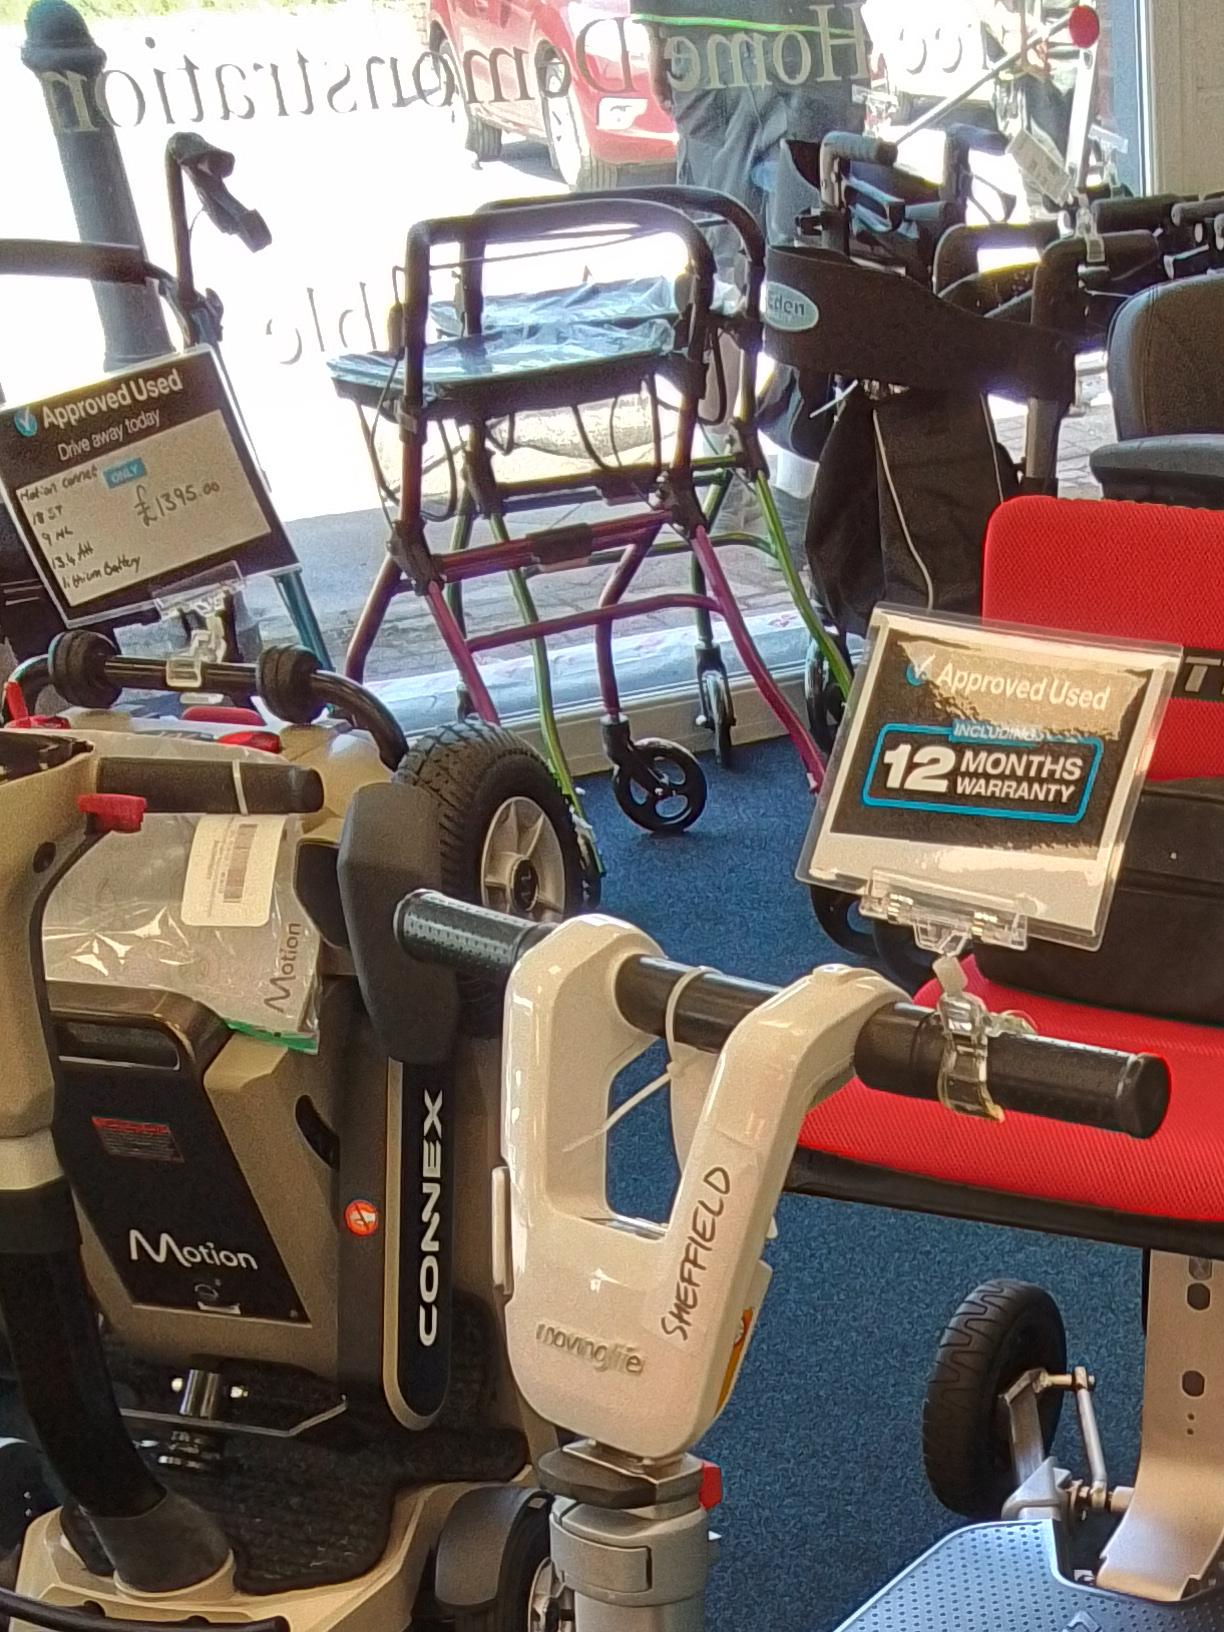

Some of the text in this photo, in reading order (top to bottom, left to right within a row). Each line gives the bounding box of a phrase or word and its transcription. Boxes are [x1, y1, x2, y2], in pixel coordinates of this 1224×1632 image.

[42, 368, 183, 429] Approved Used
[58, 408, 161, 461] Drive away today
[110, 465, 139, 484] ONLY
[937, 662, 1111, 711] Approved Used
[883, 743, 1084, 793] 12 MONTHS
[956, 776, 1075, 803] WARRANTY
[264, 923, 301, 1013] Motion
[419, 1090, 443, 1347] CONNEX
[129, 1228, 258, 1270] Motion
[660, 1166, 731, 1341] SHEFFIELD
